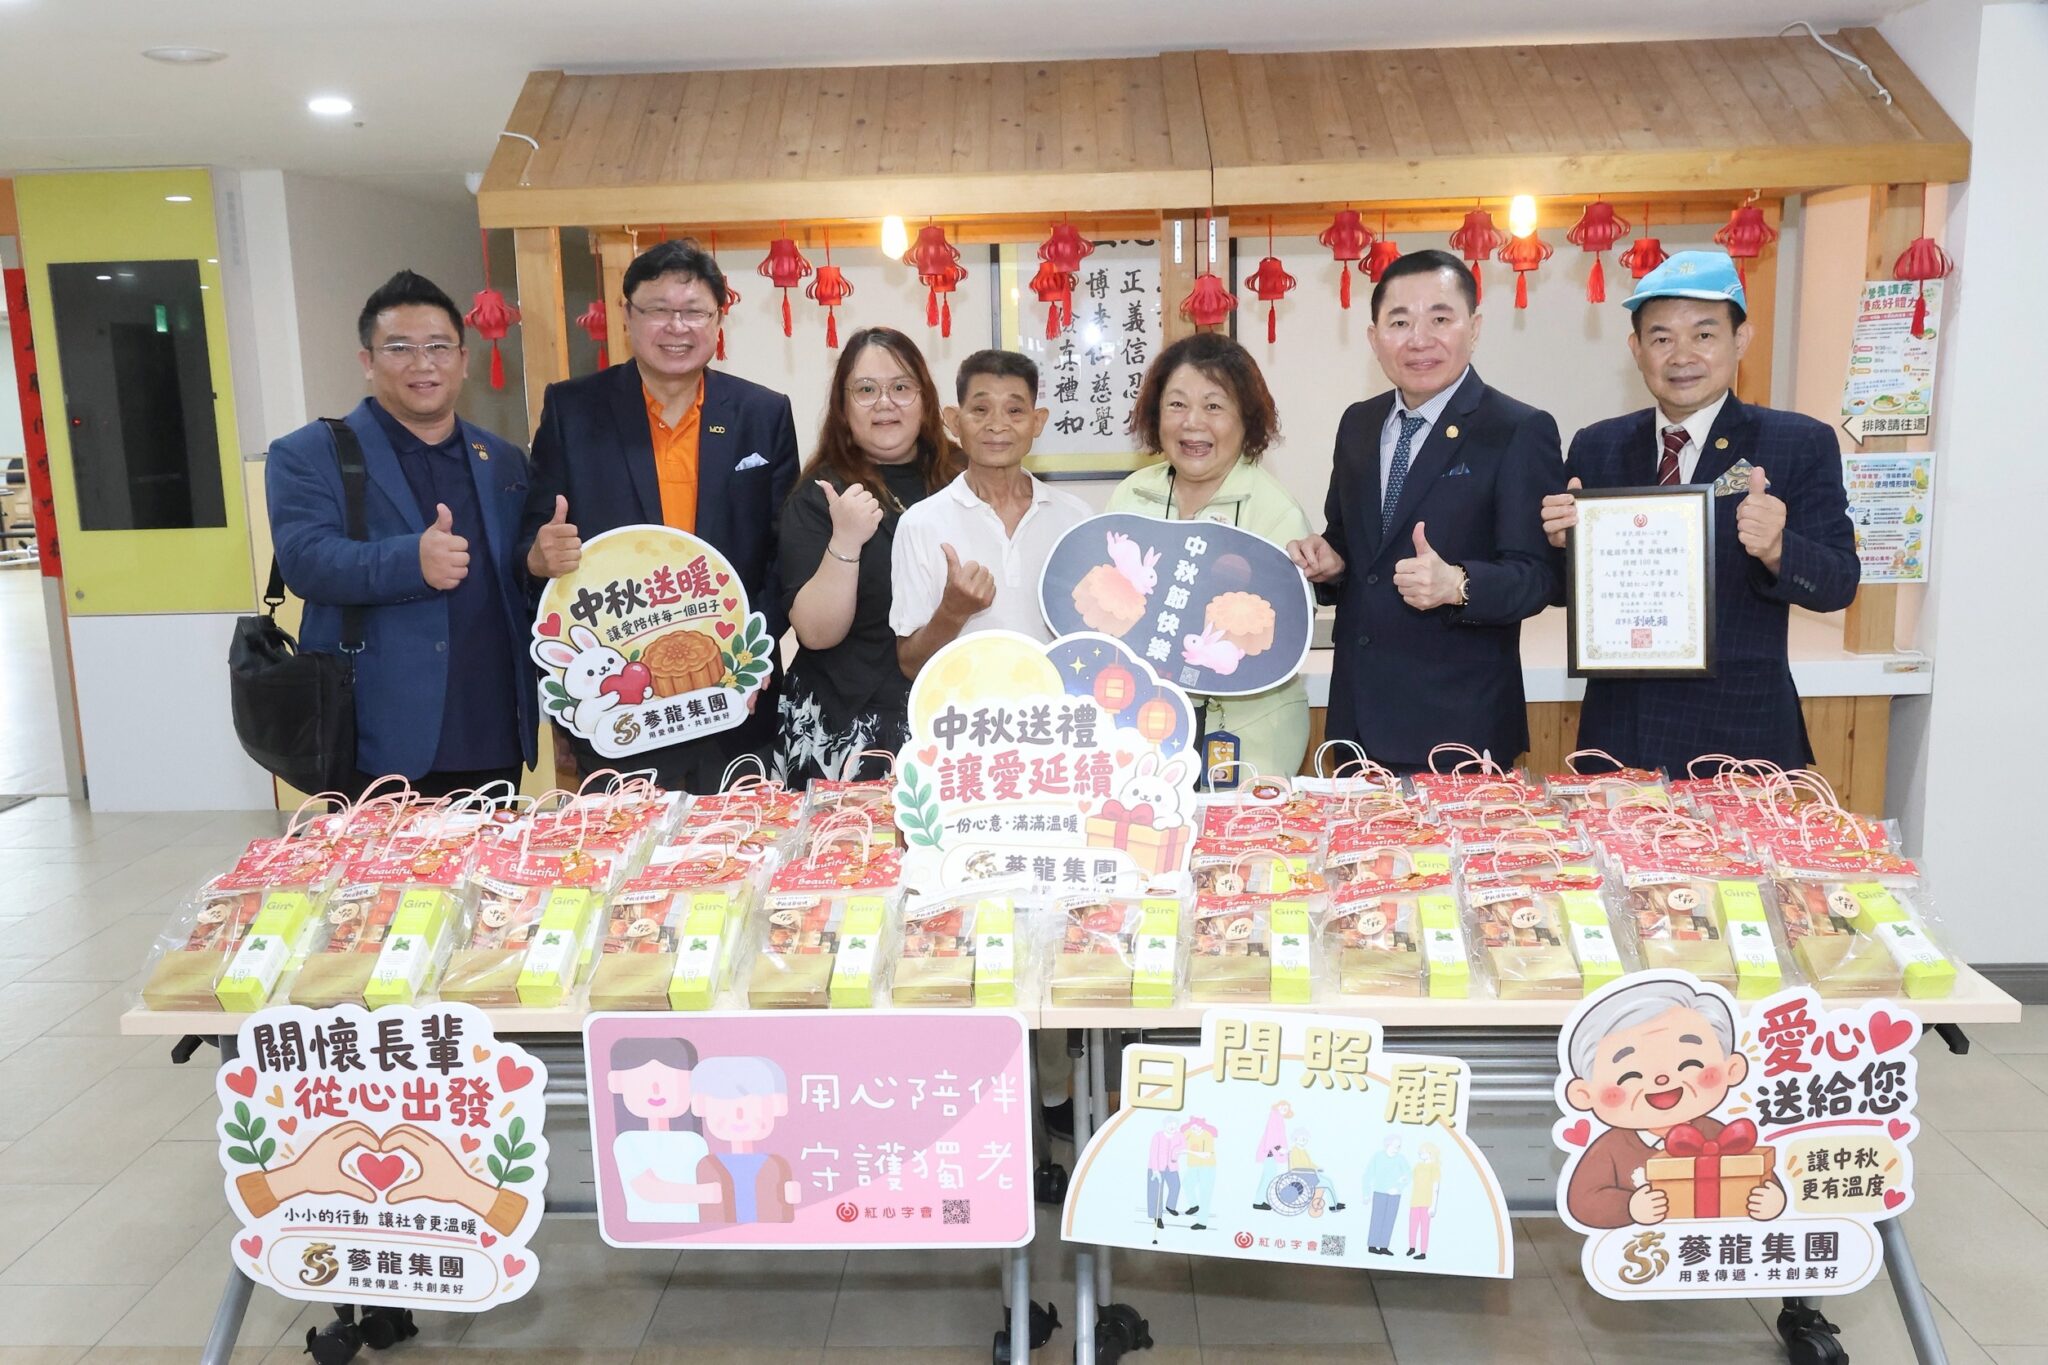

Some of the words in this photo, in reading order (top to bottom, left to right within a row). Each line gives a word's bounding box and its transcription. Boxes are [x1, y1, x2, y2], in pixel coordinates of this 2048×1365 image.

[570, 555, 720, 628] 中秋送暖
[1146, 535, 1208, 663] 中秋節快樂
[606, 599, 720, 642] 讓愛陪伴每一個日子
[933, 703, 1098, 750] 中秋送禮
[938, 750, 1114, 803] 讓愛延續
[945, 814, 1078, 834] 一份心意·滿滿溫暖
[508, 863, 560, 878] Bautiful
[254, 1013, 464, 1075] 關懷長輩
[1758, 998, 1865, 1077] 愛心
[800, 1069, 1017, 1116] 用心陪伴
[1128, 1018, 1461, 1128] 日間照顧
[1756, 1061, 1907, 1126] 送給您
[294, 1076, 494, 1128] 從心出發
[800, 1142, 1013, 1191] 守護獨老
[1807, 1147, 1879, 1172] 讓中秋
[1802, 1174, 1885, 1201] 更有溫度
[285, 1208, 369, 1226] 小小的行動
[379, 1212, 478, 1237] 讓社會更溫暖
[864, 1206, 933, 1219] 紅心字會
[347, 1248, 464, 1279] 蔘龍集團
[1258, 1238, 1318, 1252] 紅心字會
[1678, 1232, 1839, 1265] 蔘龍集團
